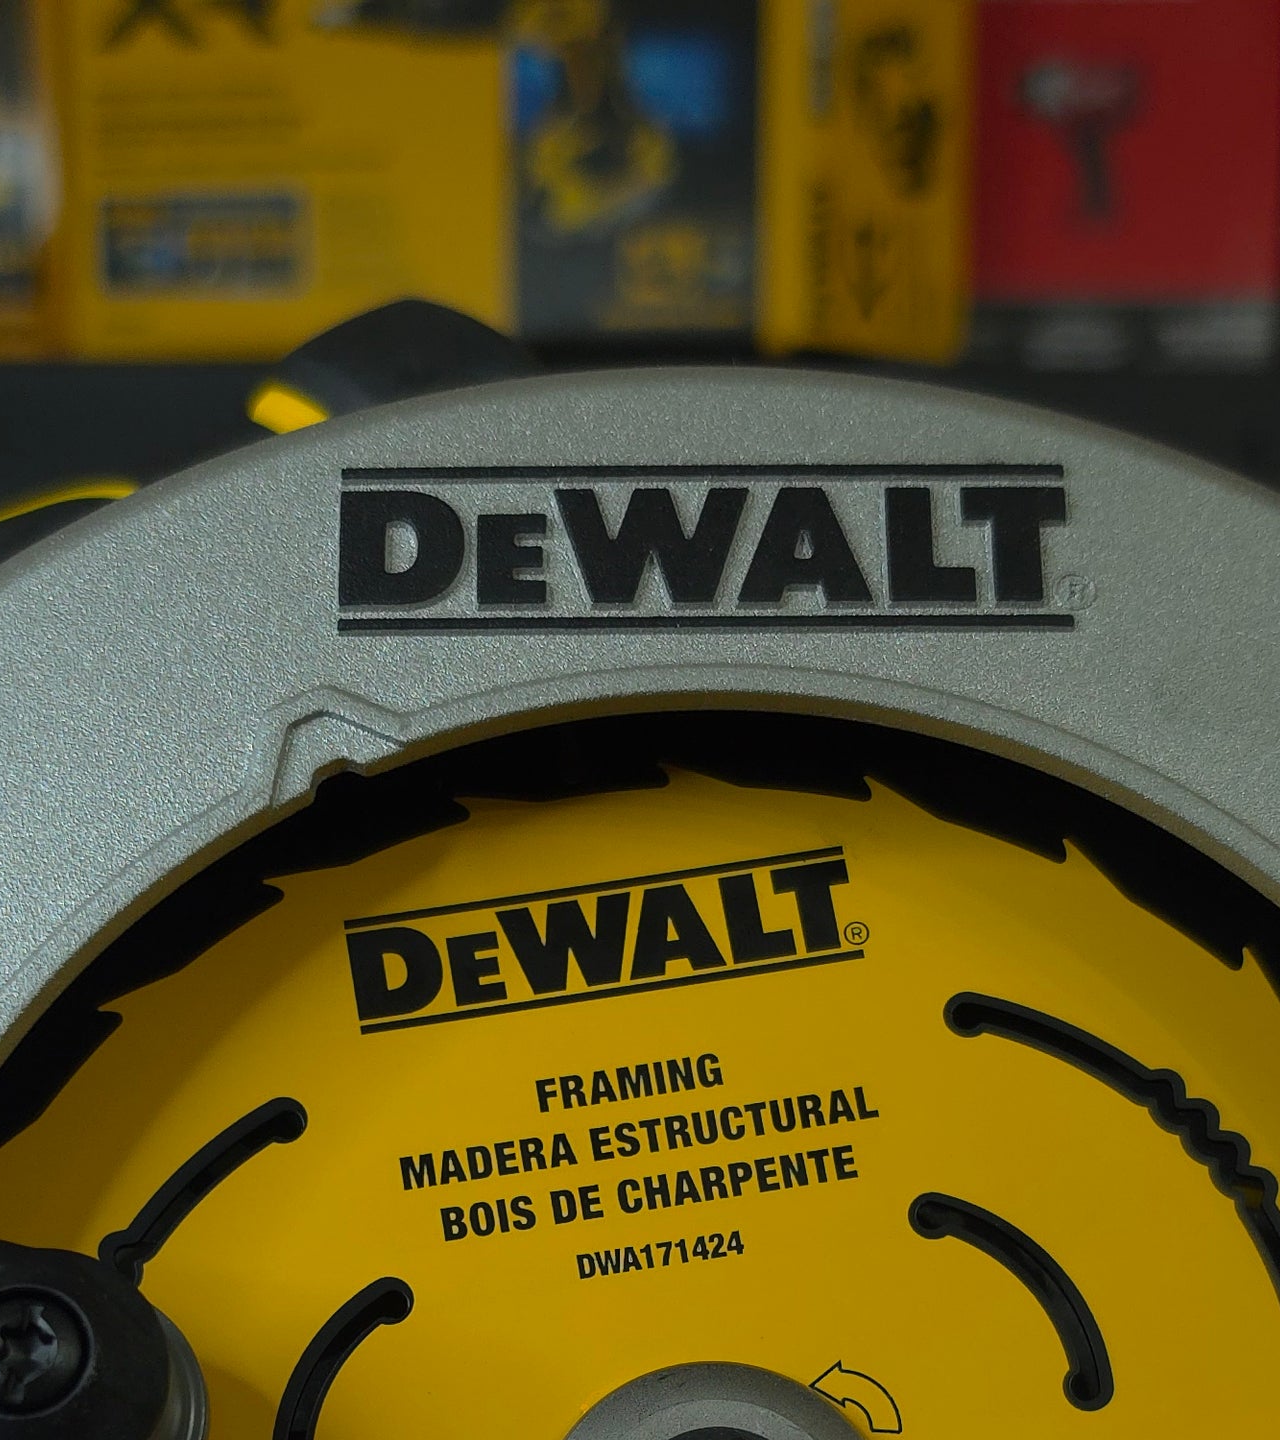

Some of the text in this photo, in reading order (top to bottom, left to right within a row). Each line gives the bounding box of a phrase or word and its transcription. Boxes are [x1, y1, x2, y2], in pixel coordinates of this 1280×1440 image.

[535, 1053, 724, 1113] FRAMING
[399, 1085, 880, 1190] MADERA ESTRUCTURAL
[440, 1145, 860, 1242] BOIS DE CHARPENTE
[576, 1230, 746, 1280] DWA171424
